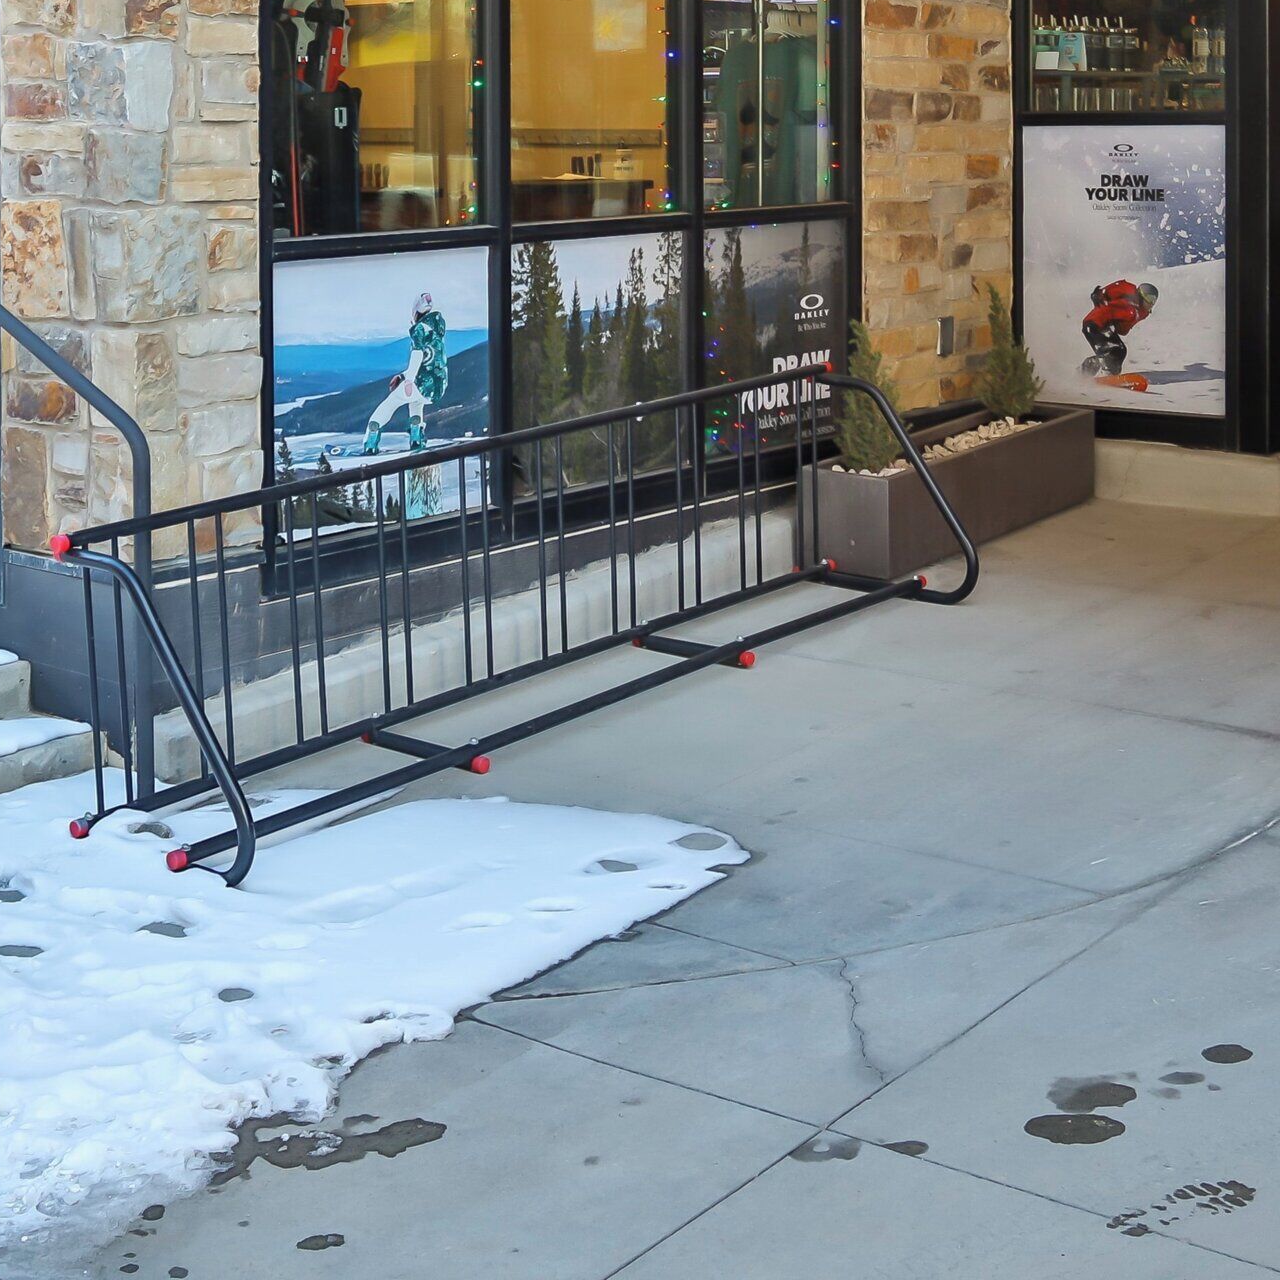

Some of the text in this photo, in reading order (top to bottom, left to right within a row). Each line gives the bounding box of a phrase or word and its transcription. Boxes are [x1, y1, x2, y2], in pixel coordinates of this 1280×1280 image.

[1100, 174, 1149, 188] DRAW
[1084, 187, 1166, 202] YOUR LINE
[794, 308, 830, 320] OAKLEY
[772, 349, 831, 374] DRAW
